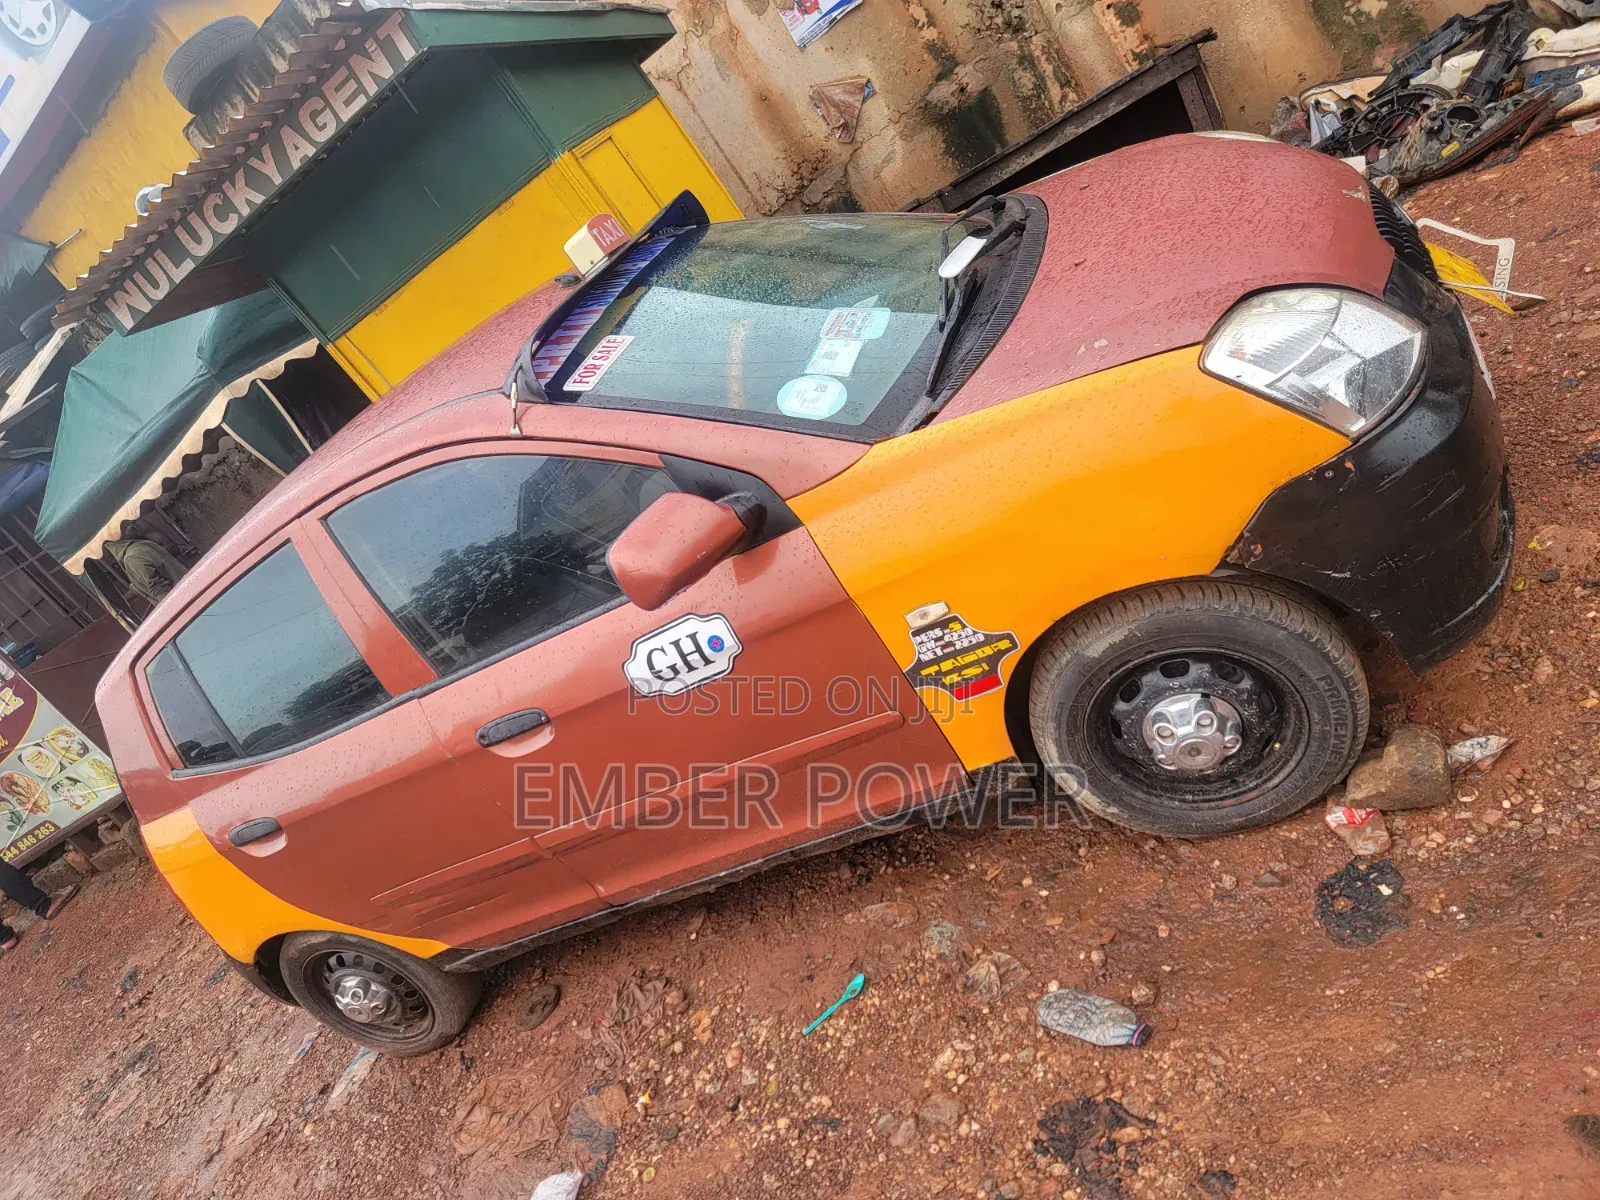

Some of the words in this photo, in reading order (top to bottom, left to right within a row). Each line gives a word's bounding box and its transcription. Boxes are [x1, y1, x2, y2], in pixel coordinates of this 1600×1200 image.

[591, 218, 625, 247] TAXI
[571, 363, 604, 385] FOR
[591, 338, 625, 361] SALE
[646, 631, 716, 682] GH
[17, 834, 37, 850] 846
[34, 822, 55, 840] 263
